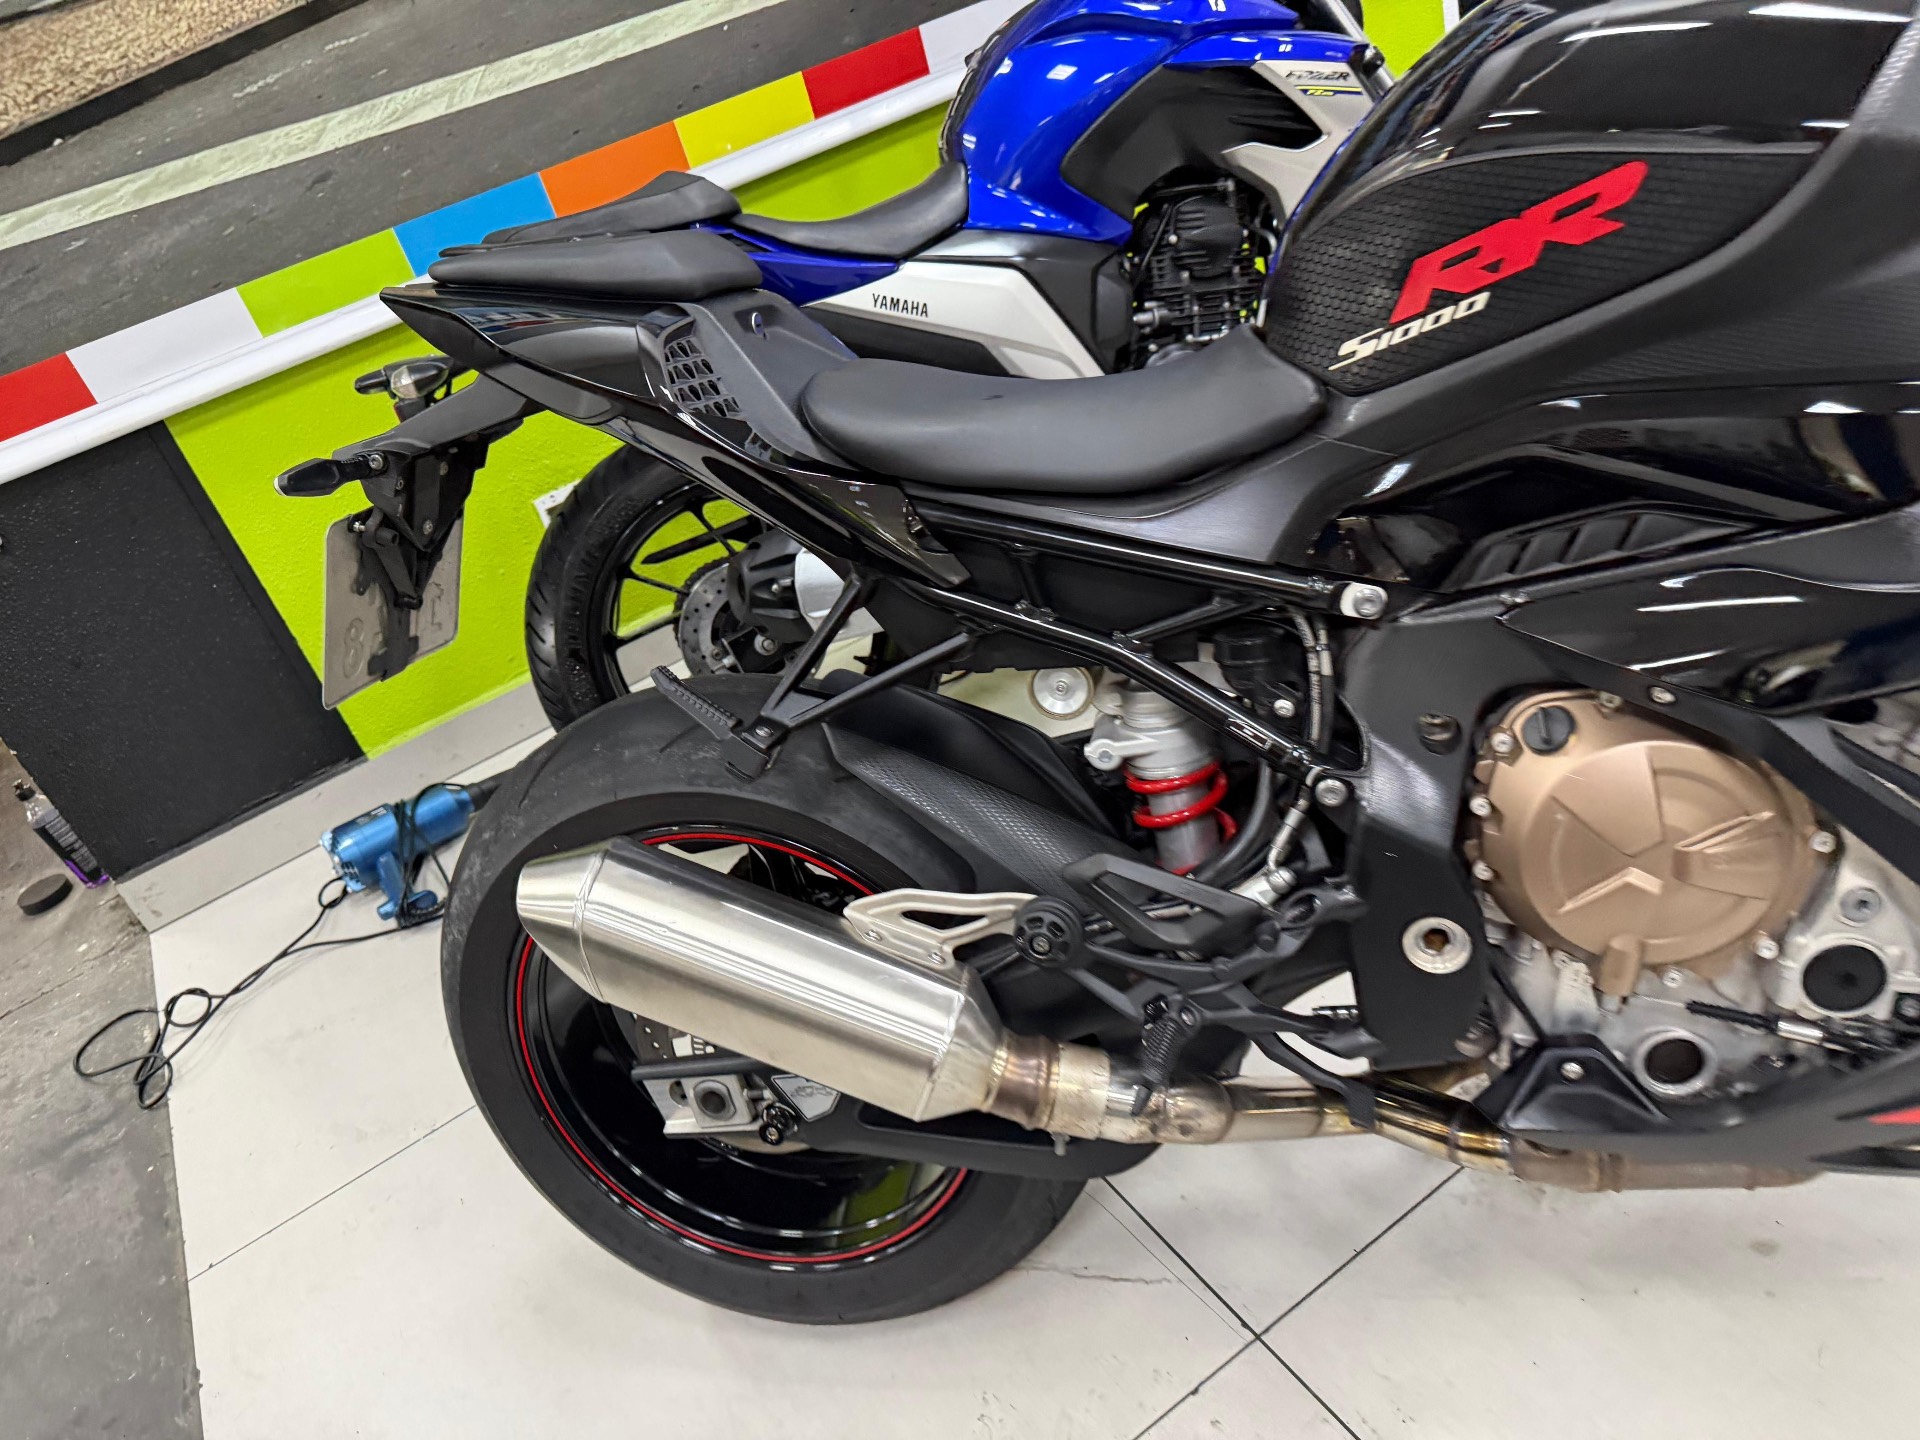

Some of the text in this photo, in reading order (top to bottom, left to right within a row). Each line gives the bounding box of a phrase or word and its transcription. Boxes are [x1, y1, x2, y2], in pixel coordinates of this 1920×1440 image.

[1389, 160, 1648, 325] RR
[872, 292, 928, 318] YAMAHA
[1328, 291, 1491, 371] S1000
